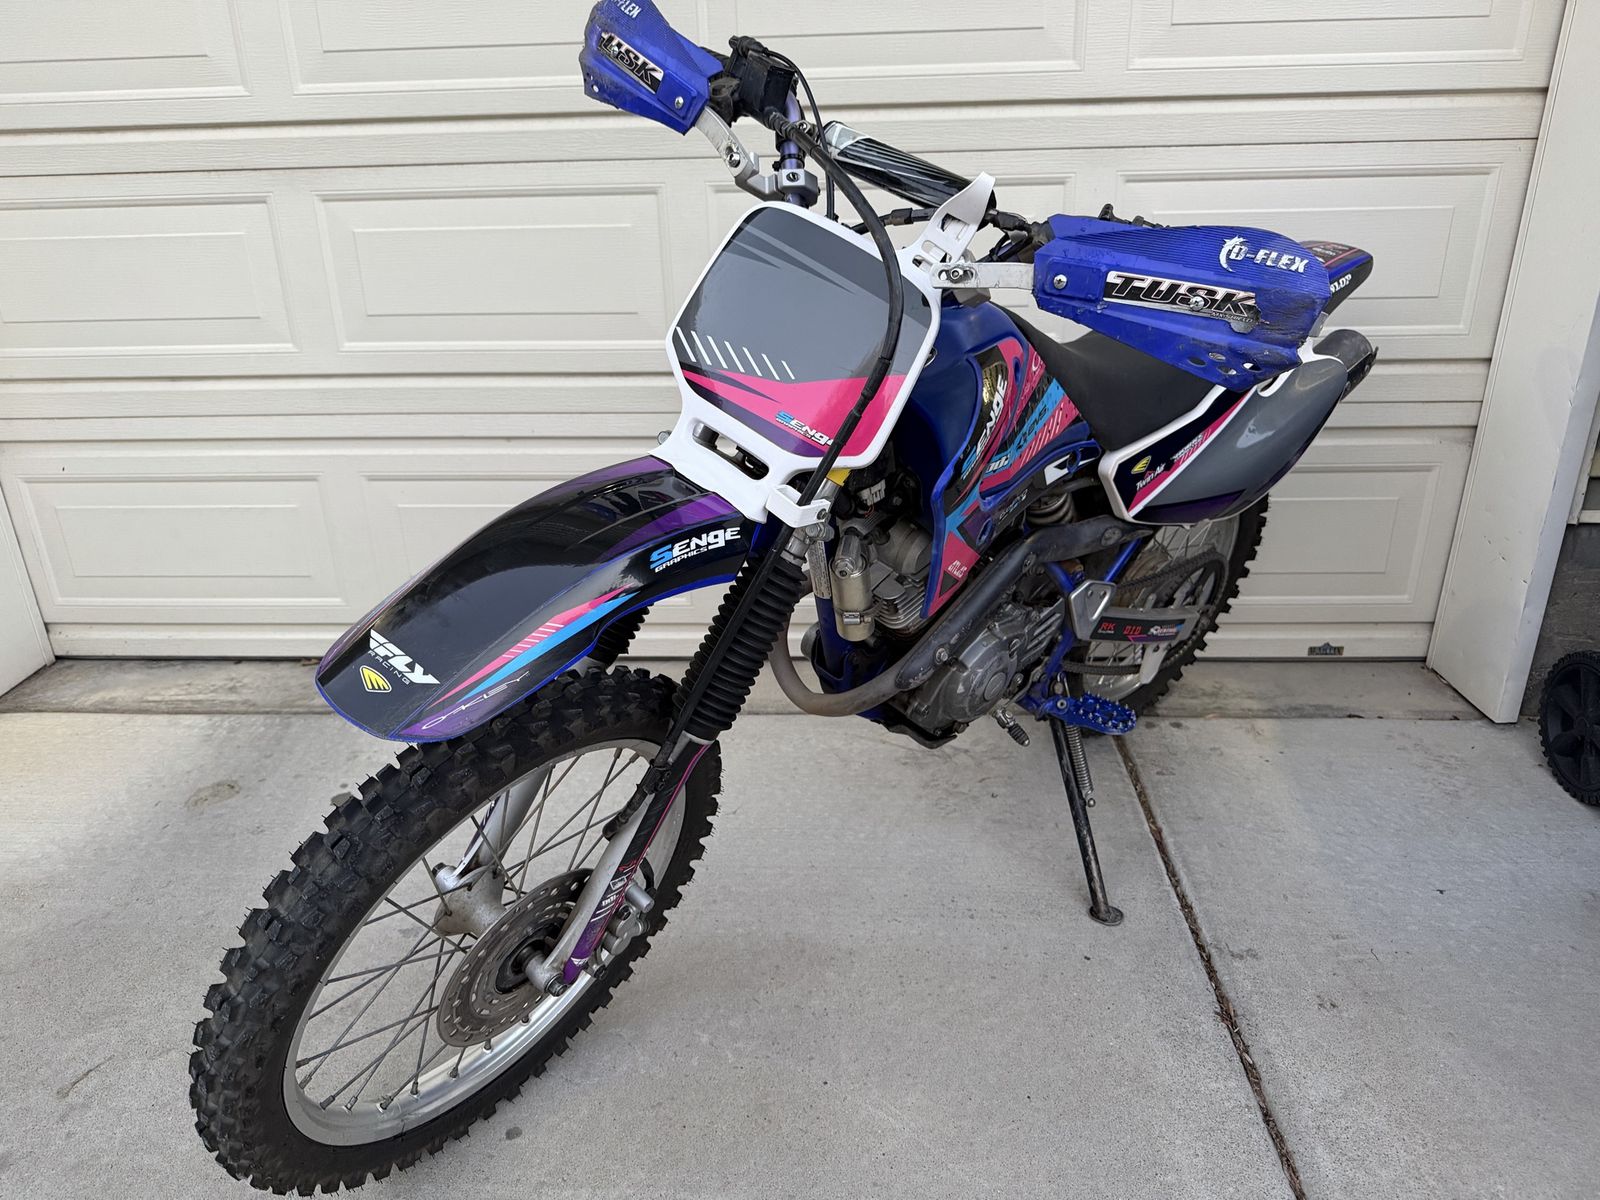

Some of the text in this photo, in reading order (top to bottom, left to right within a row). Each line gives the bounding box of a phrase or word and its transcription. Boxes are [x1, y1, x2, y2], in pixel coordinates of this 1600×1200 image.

[1229, 244, 1309, 273] D-FLEX
[1113, 272, 1256, 317] TUSK
[654, 546, 708, 573] GRAPHICS
[367, 649, 411, 685] RACING
[369, 628, 441, 685] FLY
